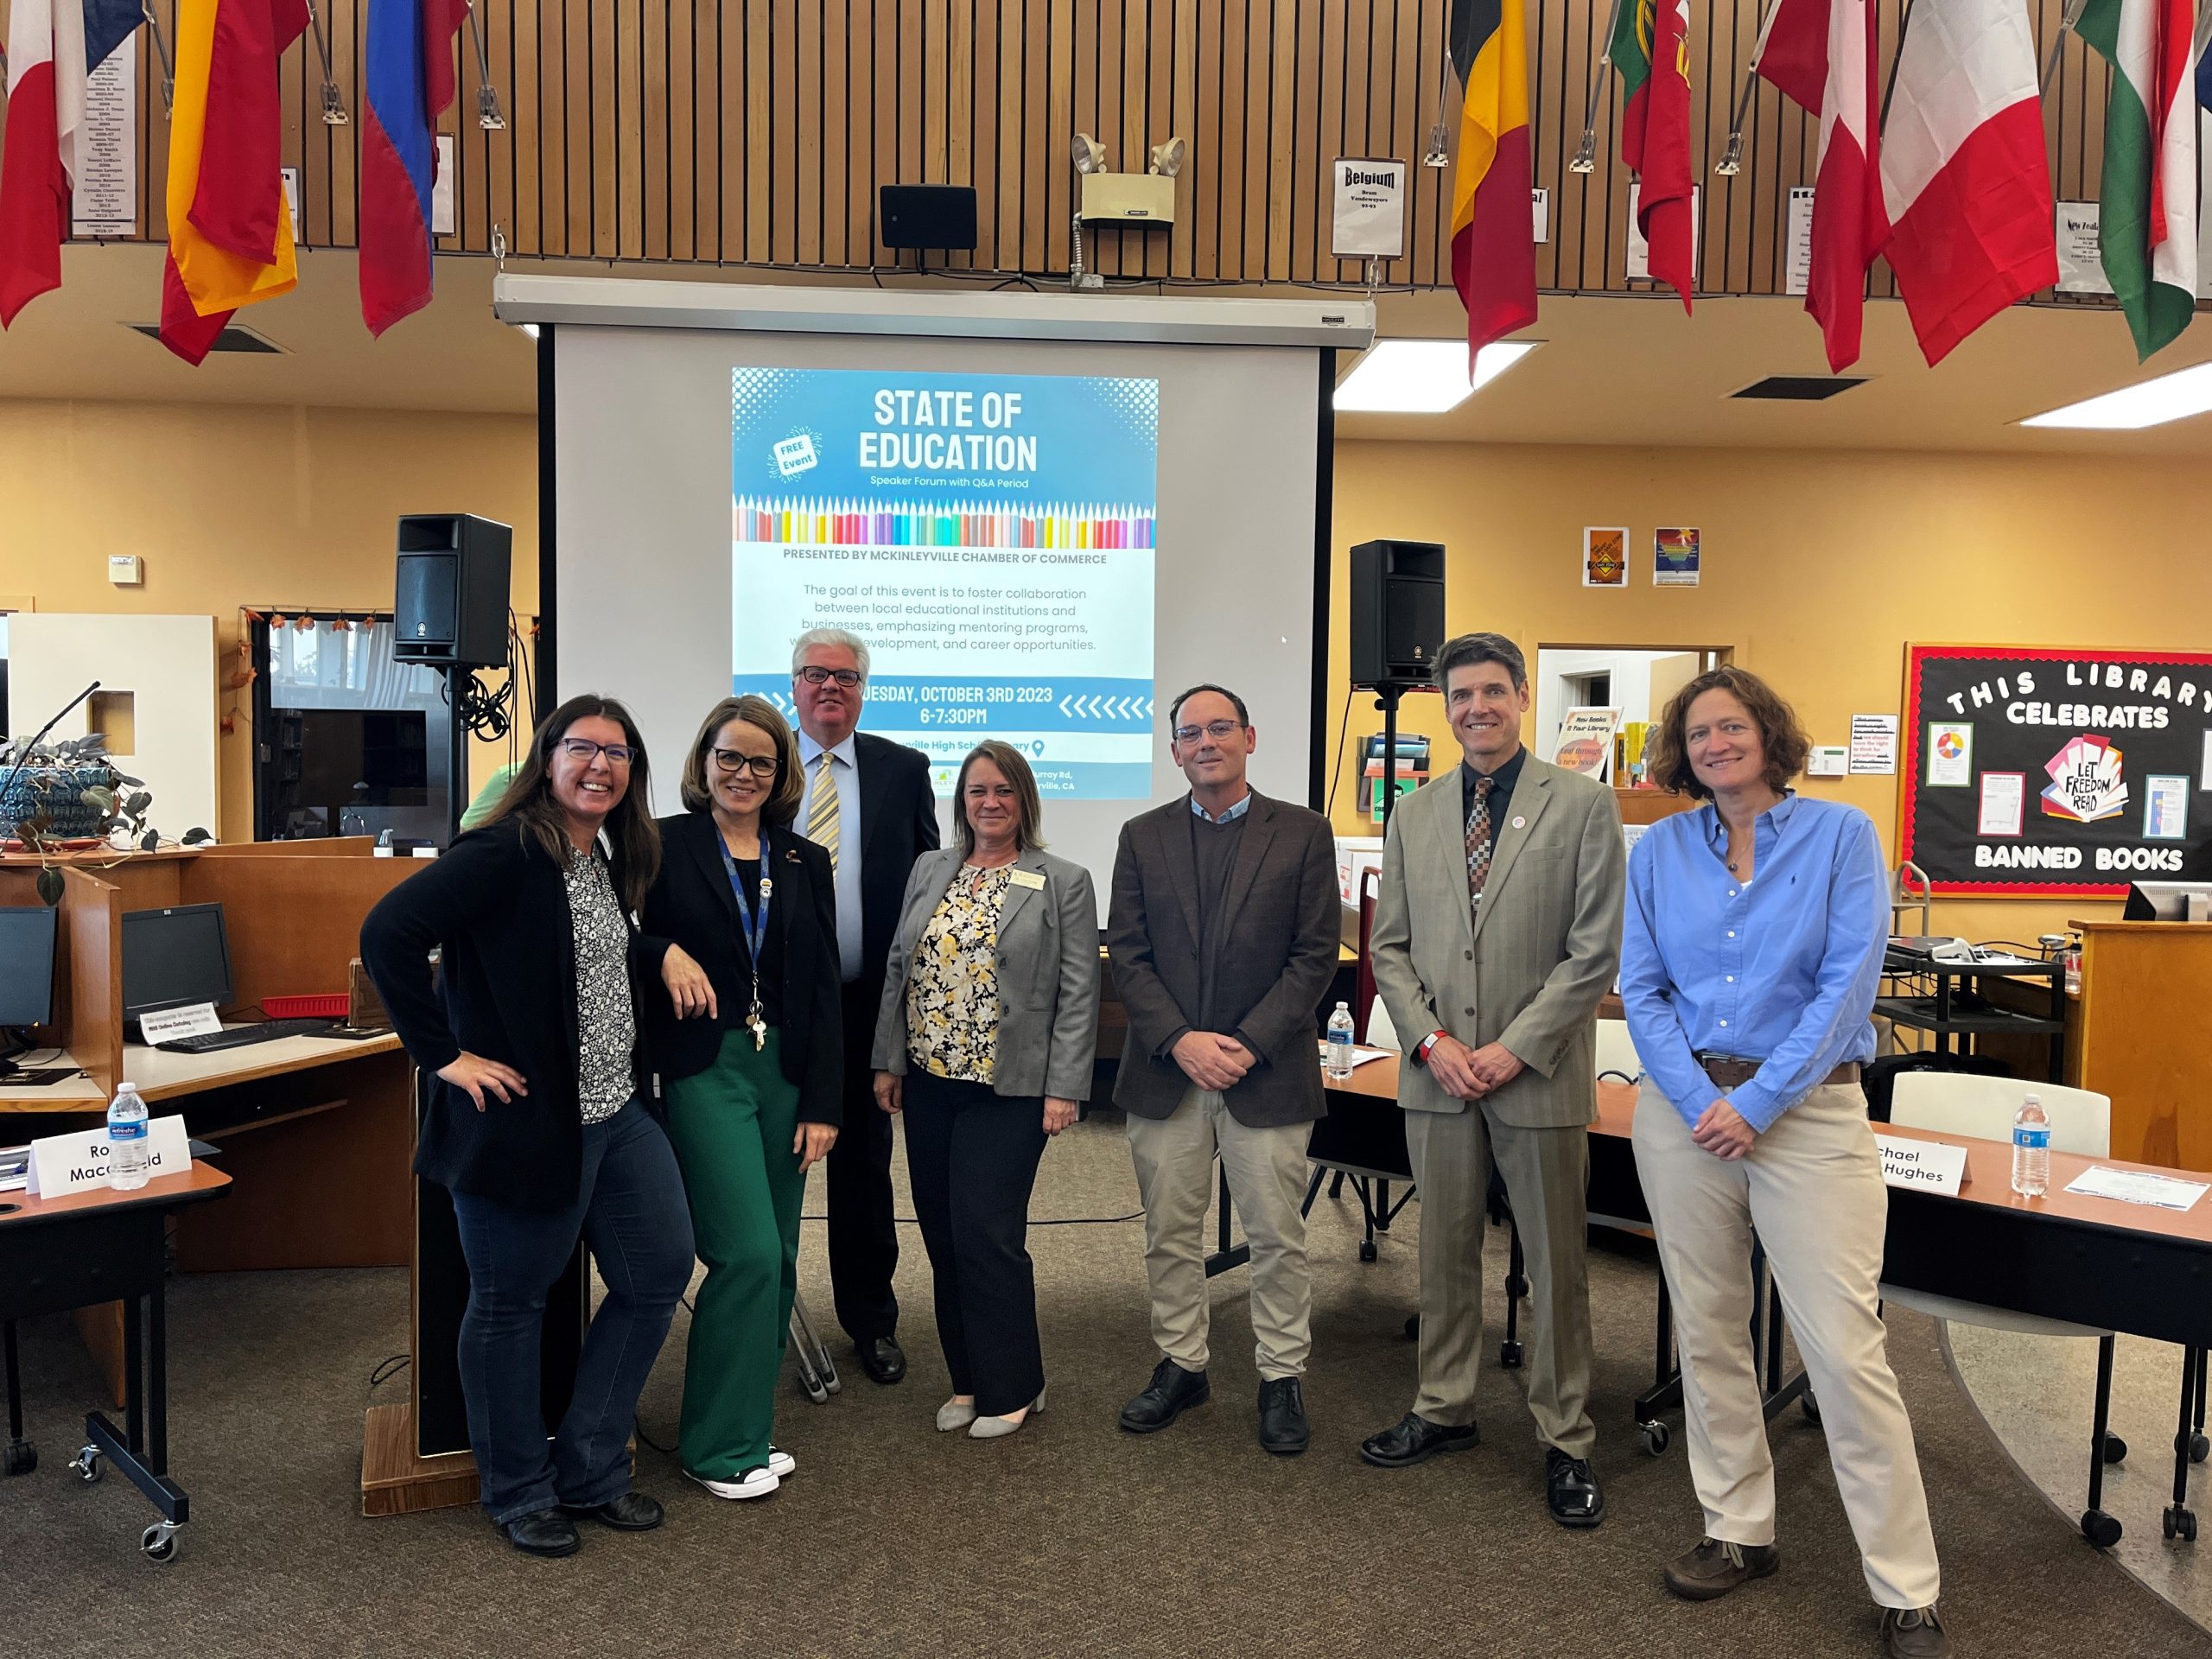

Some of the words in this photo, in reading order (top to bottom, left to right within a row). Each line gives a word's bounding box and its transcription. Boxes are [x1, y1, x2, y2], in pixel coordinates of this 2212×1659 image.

[1345, 166, 1395, 189] Belgium
[874, 388, 974, 429] STATE
[982, 391, 1022, 429] OF
[780, 441, 804, 456] FREE
[859, 431, 1037, 472] EDUCATION
[783, 454, 813, 470] Event
[870, 475, 912, 488] Speaker
[914, 477, 947, 487] Forum
[949, 476, 970, 486] with
[972, 478, 995, 489] Q&A
[997, 478, 1029, 488] Period
[784, 549, 849, 561] PRESENTED
[852, 550, 867, 561] BY
[870, 550, 959, 563] MCKINLEYVILLE
[962, 552, 1020, 563] CHAMBER
[1022, 553, 1037, 564] OF
[1039, 554, 1107, 564] COMMERCE
[804, 584, 826, 595] The
[830, 585, 857, 598] goal
[861, 585, 874, 596] of
[876, 585, 899, 596] this
[901, 587, 937, 597] event
[939, 587, 949, 597] is
[952, 588, 964, 598] to
[968, 587, 1002, 598] foster
[1006, 588, 1086, 599] collaboration
[815, 601, 868, 613] between
[872, 603, 902, 614] local
[906, 603, 979, 615] educational
[982, 605, 1049, 616] institutions
[1052, 606, 1076, 616] and
[802, 619, 874, 632] businesses,
[876, 620, 956, 635] emphasizing
[959, 622, 1022, 636] mentoring
[1026, 623, 1088, 637] programs,
[864, 638, 939, 651] evelopment,
[943, 639, 967, 649] and
[970, 640, 1011, 650] career
[1014, 639, 1096, 652] opportunities.
[862, 685, 918, 704] UESDAY,
[920, 686, 983, 702] OCTOBER
[986, 687, 1014, 702] 3RD
[1016, 687, 1052, 702] 2023
[1947, 671, 2036, 715] THIS
[2067, 663, 2212, 714] LIBRARY
[919, 708, 987, 724] 6-7:30PM
[2006, 702, 2170, 729] CELEBRATES
[931, 740, 957, 752] High
[958, 741, 978, 749] Sch
[1575, 747, 1602, 756] through
[1033, 771, 1058, 781] urray
[1059, 771, 1072, 780] Rd,
[2077, 761, 2098, 779] LET
[2065, 775, 2111, 797] FREEDOM
[2073, 794, 2097, 813] READ
[1975, 844, 2083, 869] BANNED
[2095, 847, 2183, 872] BOOKS
[1878, 1147, 1920, 1162] chael
[70, 1153, 162, 1182] Macld
